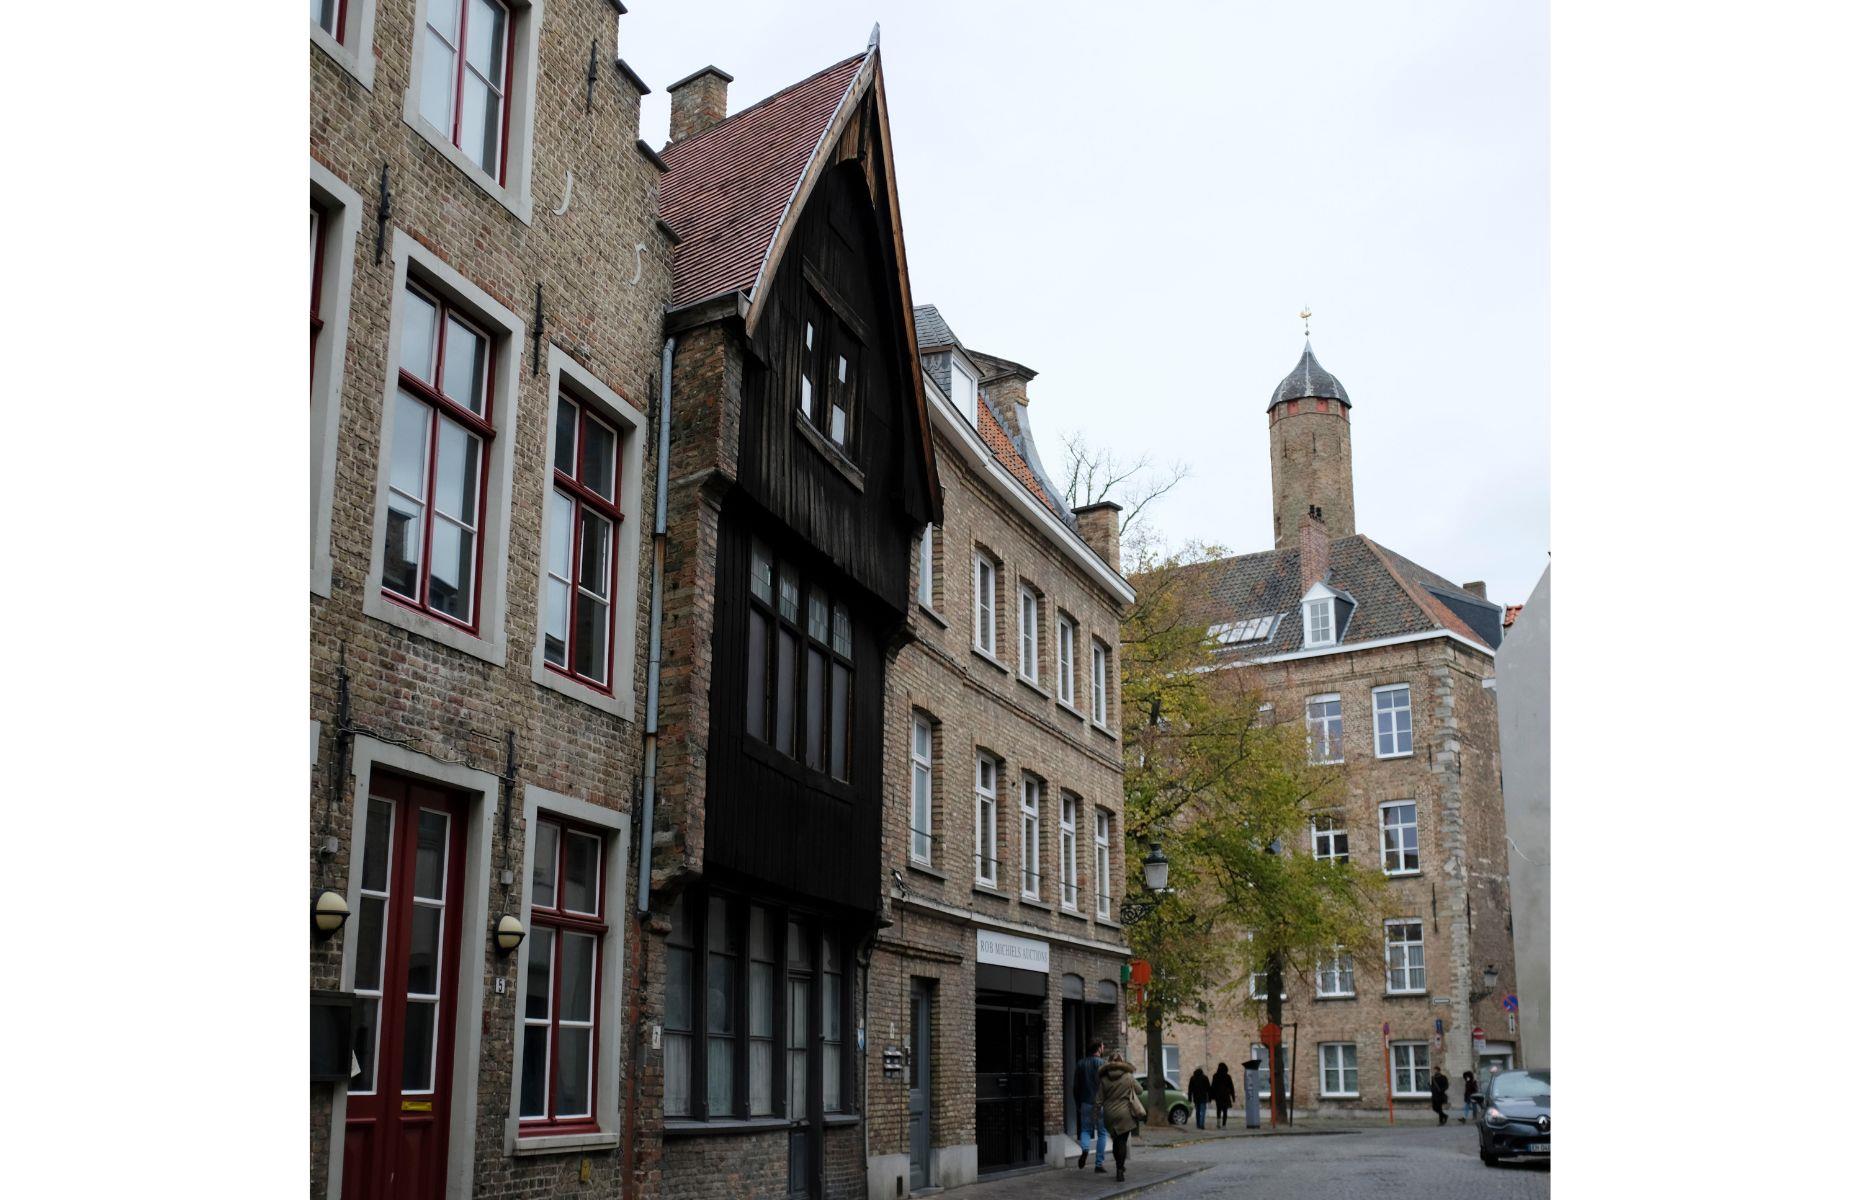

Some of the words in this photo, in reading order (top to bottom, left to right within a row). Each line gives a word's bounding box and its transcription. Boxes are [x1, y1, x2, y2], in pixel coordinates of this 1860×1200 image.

[980, 940, 994, 954] ROB
[995, 943, 1021, 959] MICHIELS
[1022, 947, 1048, 962] AUCTIONS
